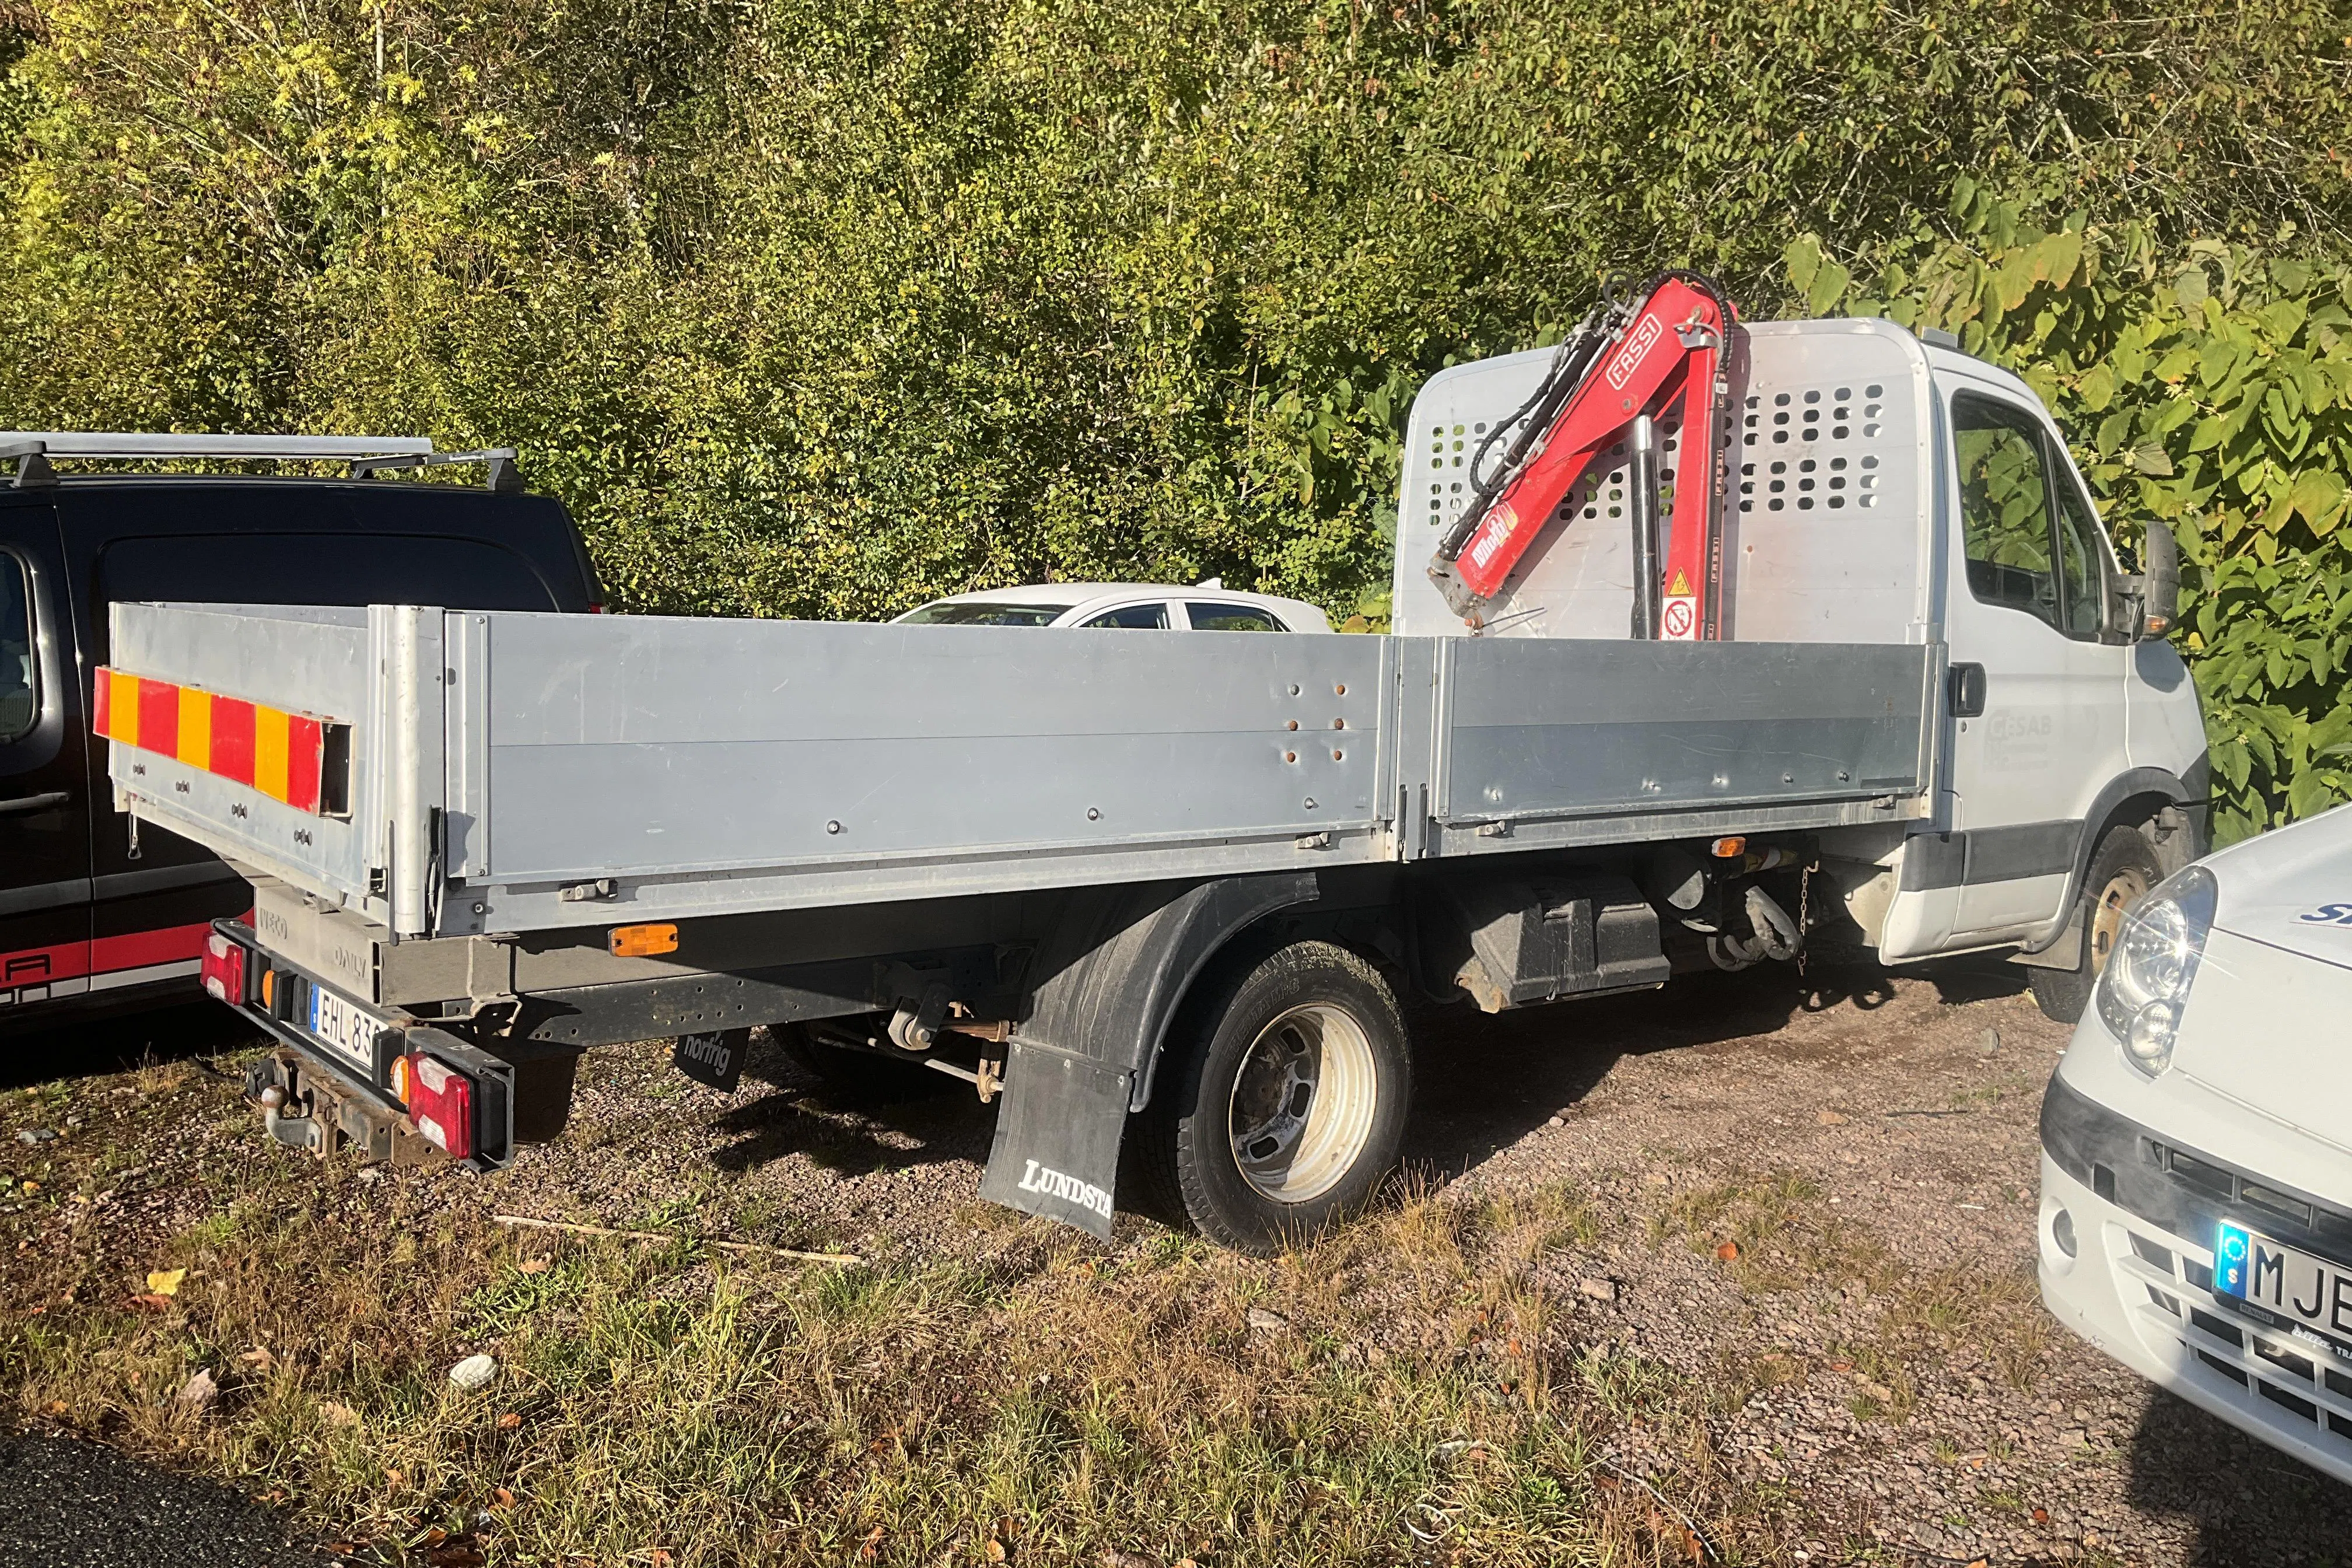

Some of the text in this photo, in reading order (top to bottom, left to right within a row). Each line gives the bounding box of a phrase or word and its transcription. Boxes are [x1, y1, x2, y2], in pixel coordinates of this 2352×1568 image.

[1612, 321, 1656, 382] FASSI
[260, 907, 288, 940] IVECO
[2300, 904, 2352, 925] S
[335, 944, 366, 978] DAILY
[322, 994, 346, 1046] EHL
[352, 1013, 380, 1058] 83
[684, 1035, 732, 1076] norfrig
[2228, 1268, 2238, 1283] S
